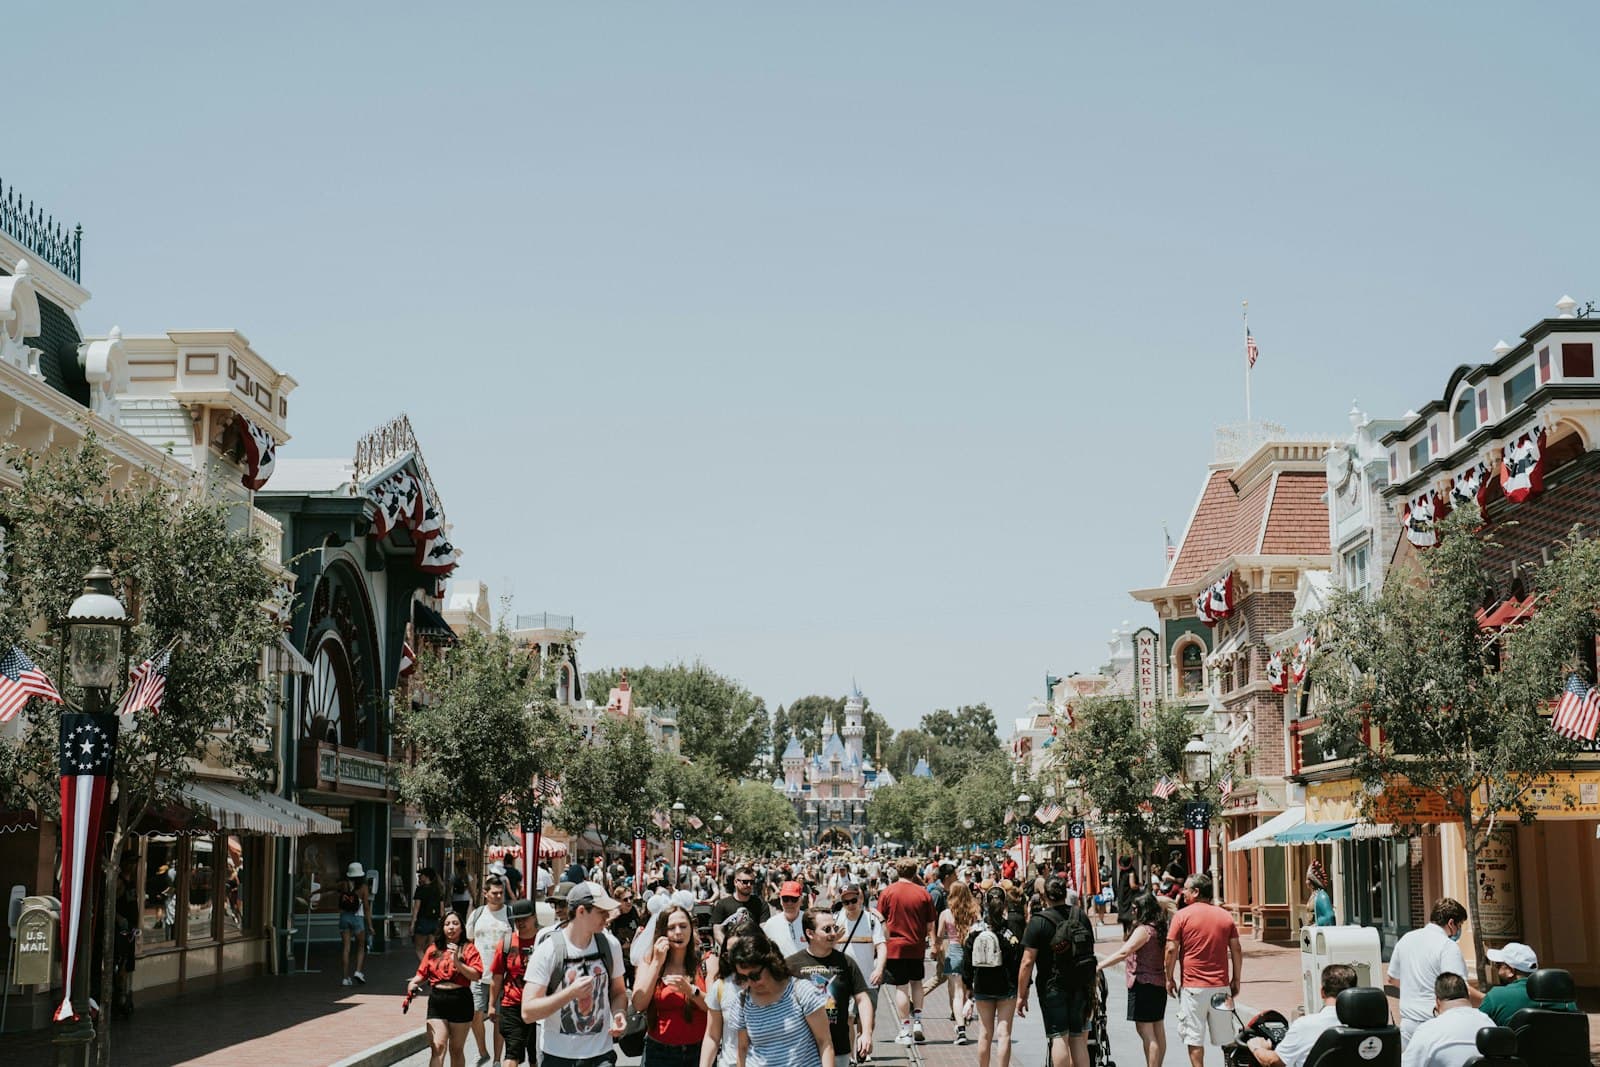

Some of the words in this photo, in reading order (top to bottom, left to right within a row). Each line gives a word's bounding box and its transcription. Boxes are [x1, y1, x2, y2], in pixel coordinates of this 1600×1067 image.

[1140, 637, 1152, 696] MARKET
[26, 931, 46, 940] U.S.
[20, 943, 48, 952] MAIL
